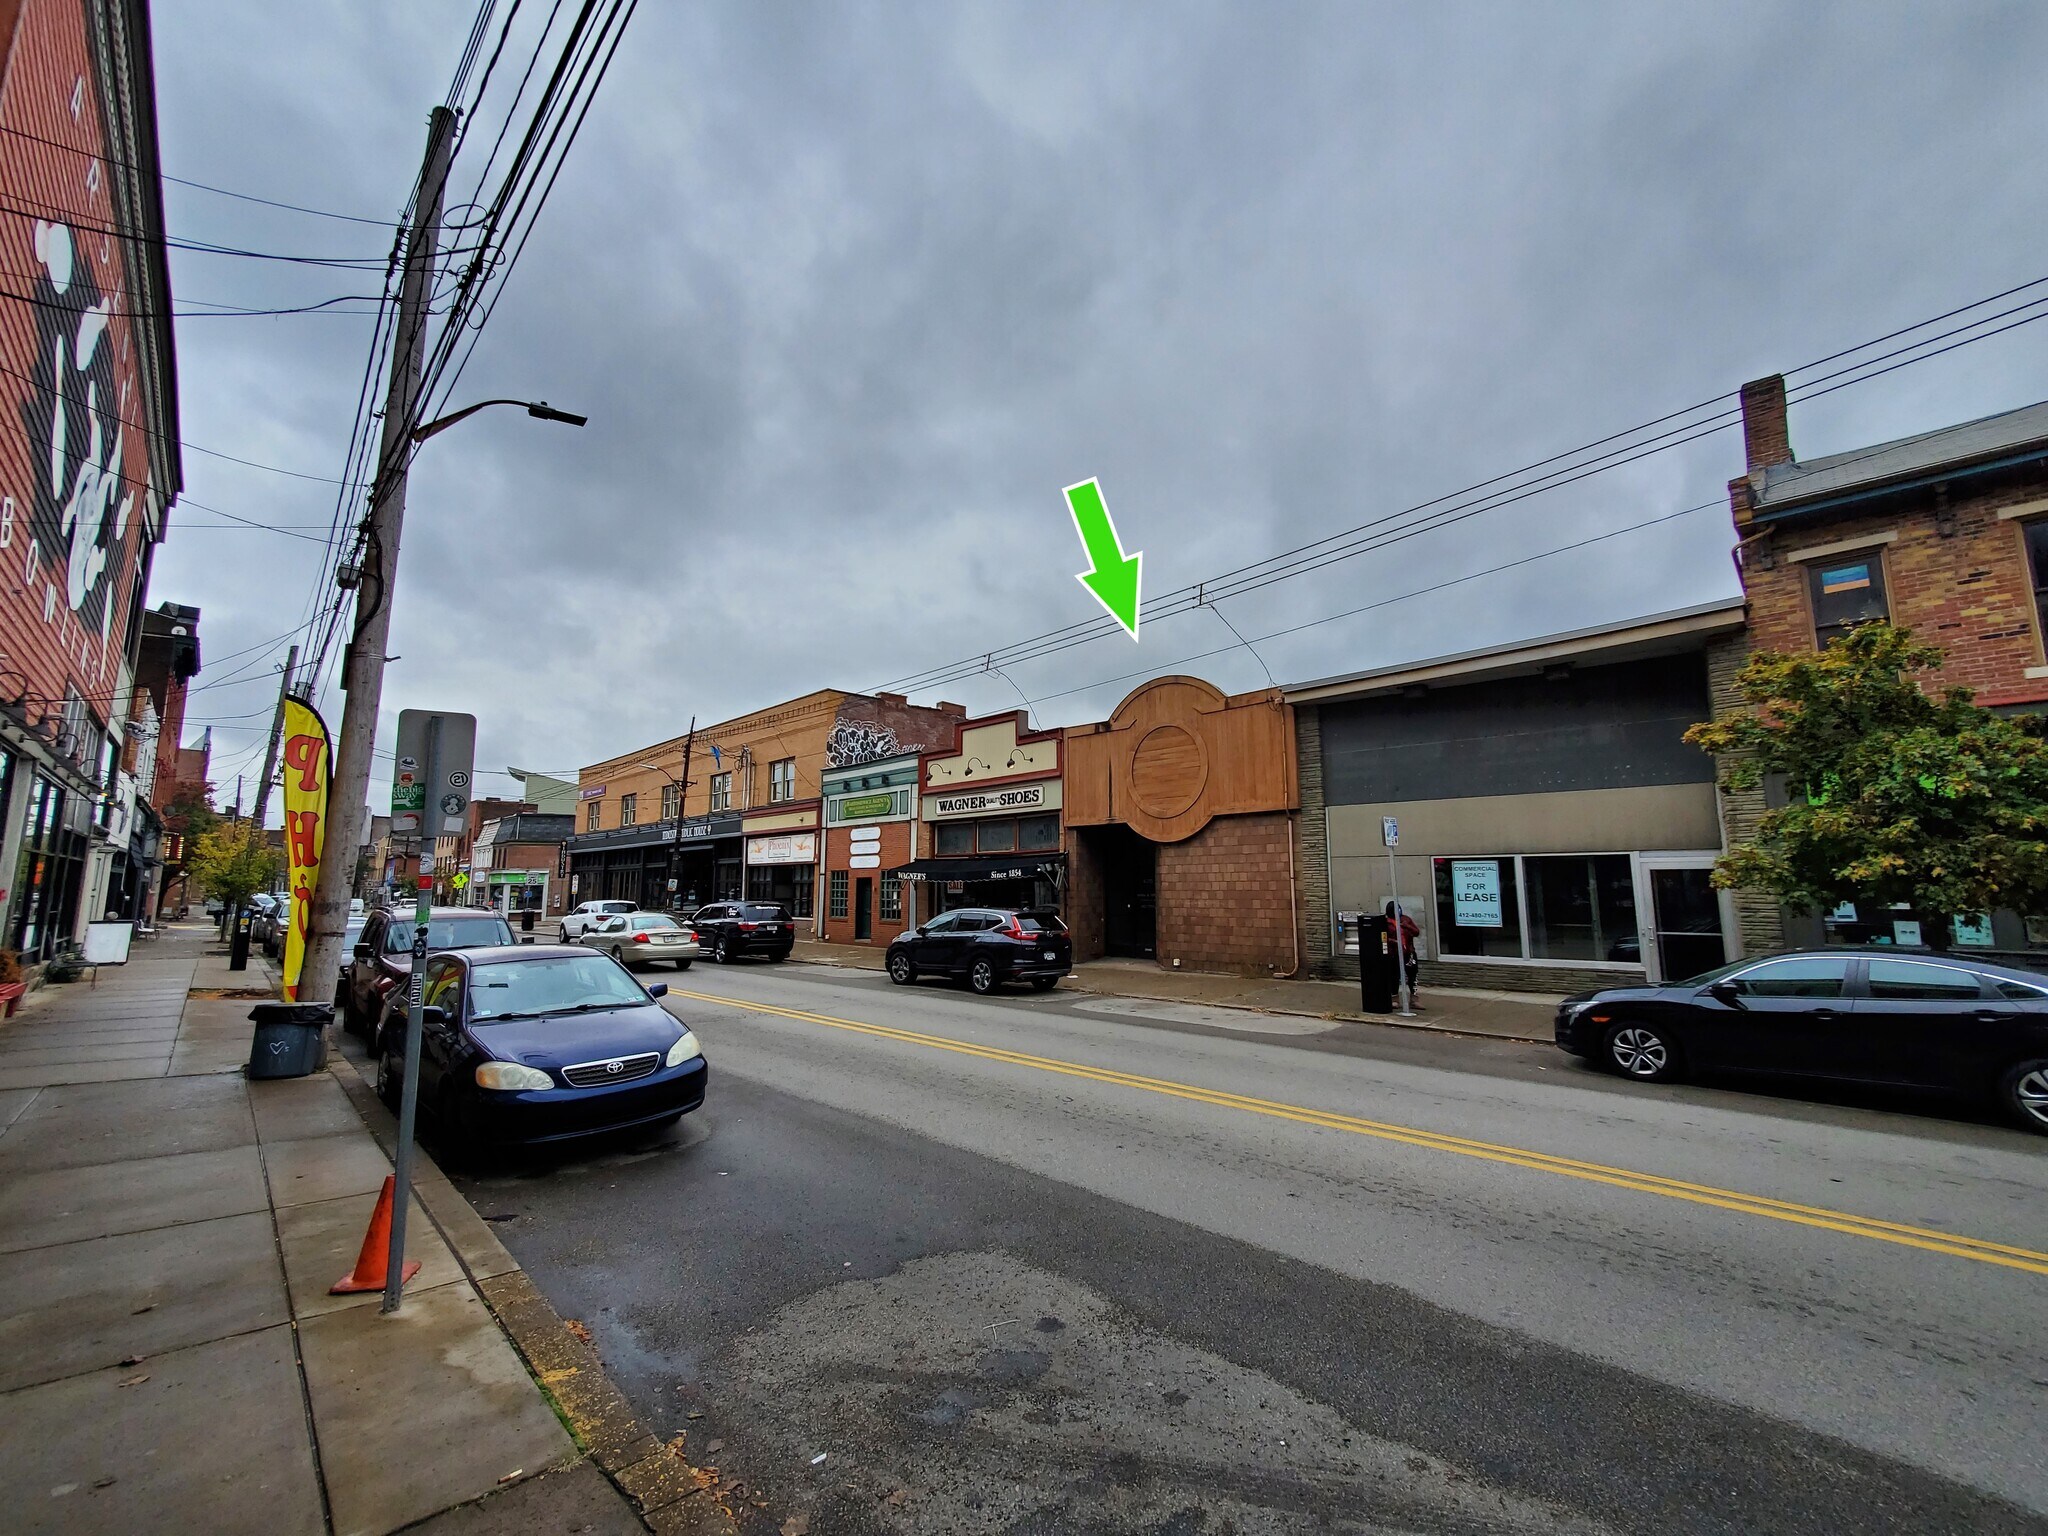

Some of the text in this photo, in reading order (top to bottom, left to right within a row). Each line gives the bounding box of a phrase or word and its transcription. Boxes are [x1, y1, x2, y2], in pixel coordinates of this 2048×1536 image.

[453, 775, 465, 784] 21
[938, 796, 986, 812] WAGNER
[999, 789, 1040, 806] SHOES
[990, 870, 1007, 879] Since
[1008, 868, 1022, 878] 1854
[948, 881, 963, 890] SALE
[1457, 893, 1497, 902] LEASE
